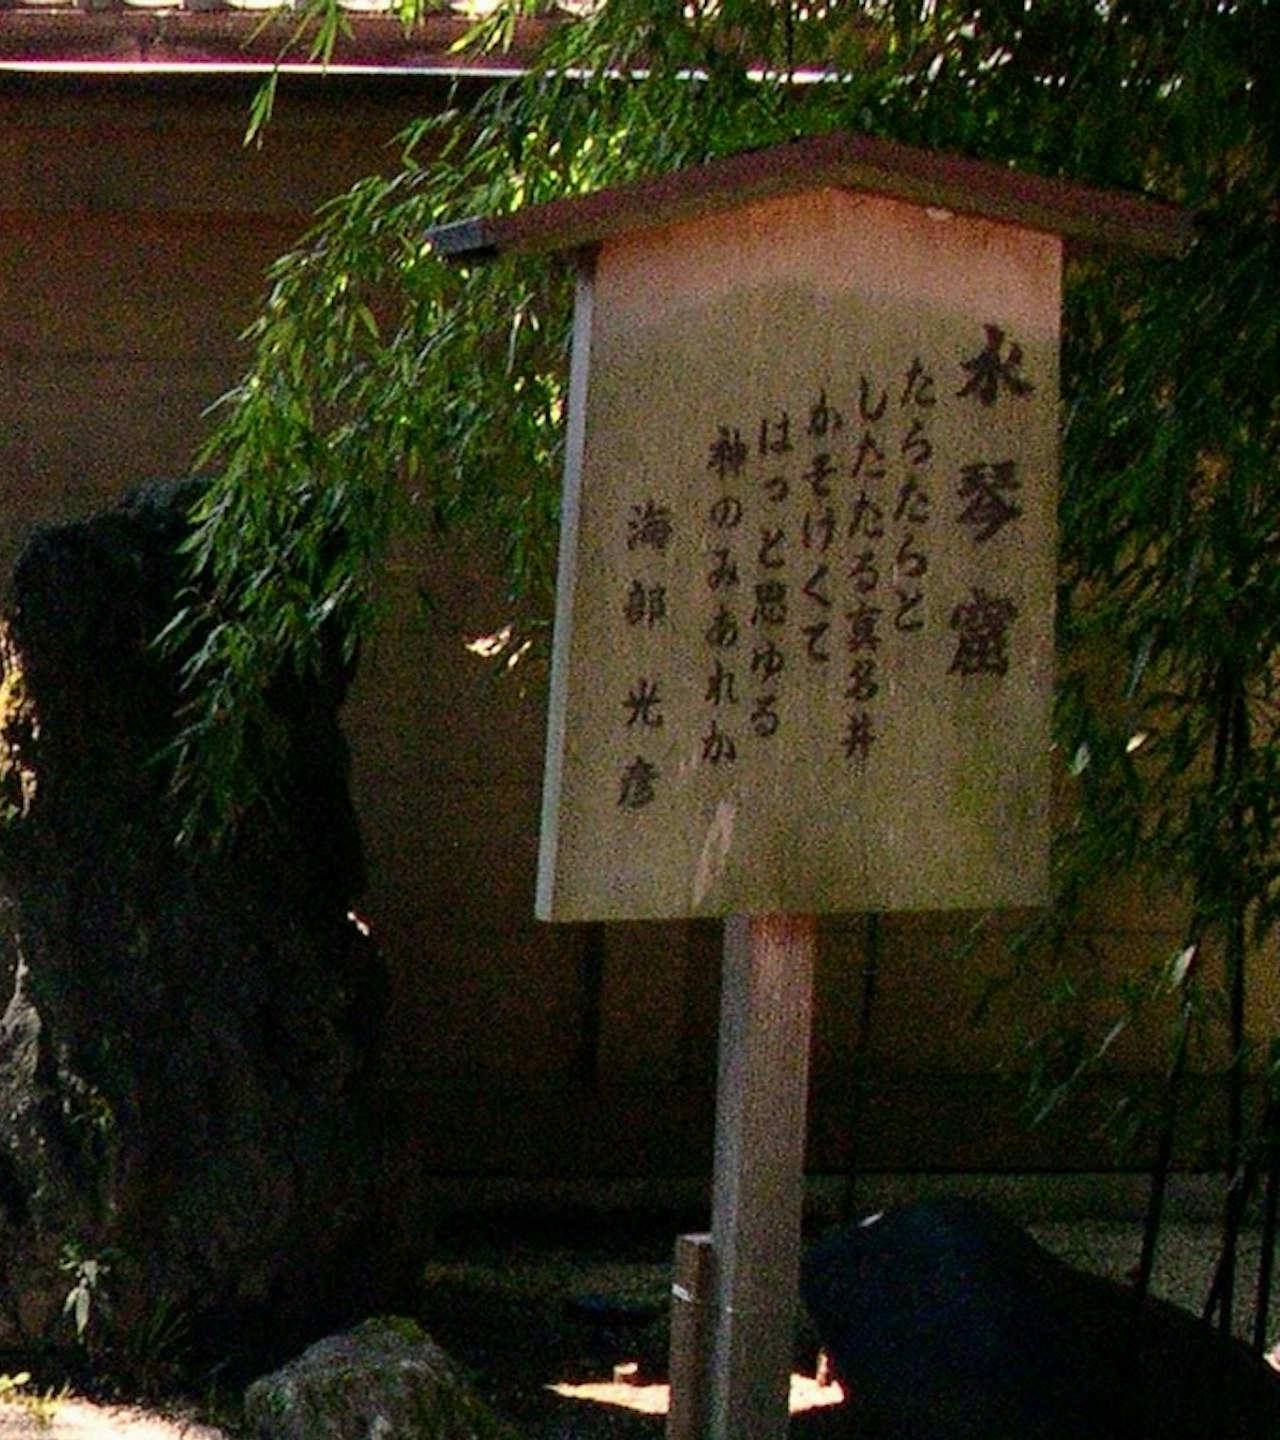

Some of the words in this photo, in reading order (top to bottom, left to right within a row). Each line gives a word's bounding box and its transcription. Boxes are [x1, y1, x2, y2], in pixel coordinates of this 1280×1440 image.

[700, 424, 748, 765] 神のみあれか
[801, 388, 842, 662] かそけくて
[841, 375, 887, 761] したたる真名井
[891, 357, 937, 632] たらたらと
[948, 322, 1035, 677] 水琴窟
